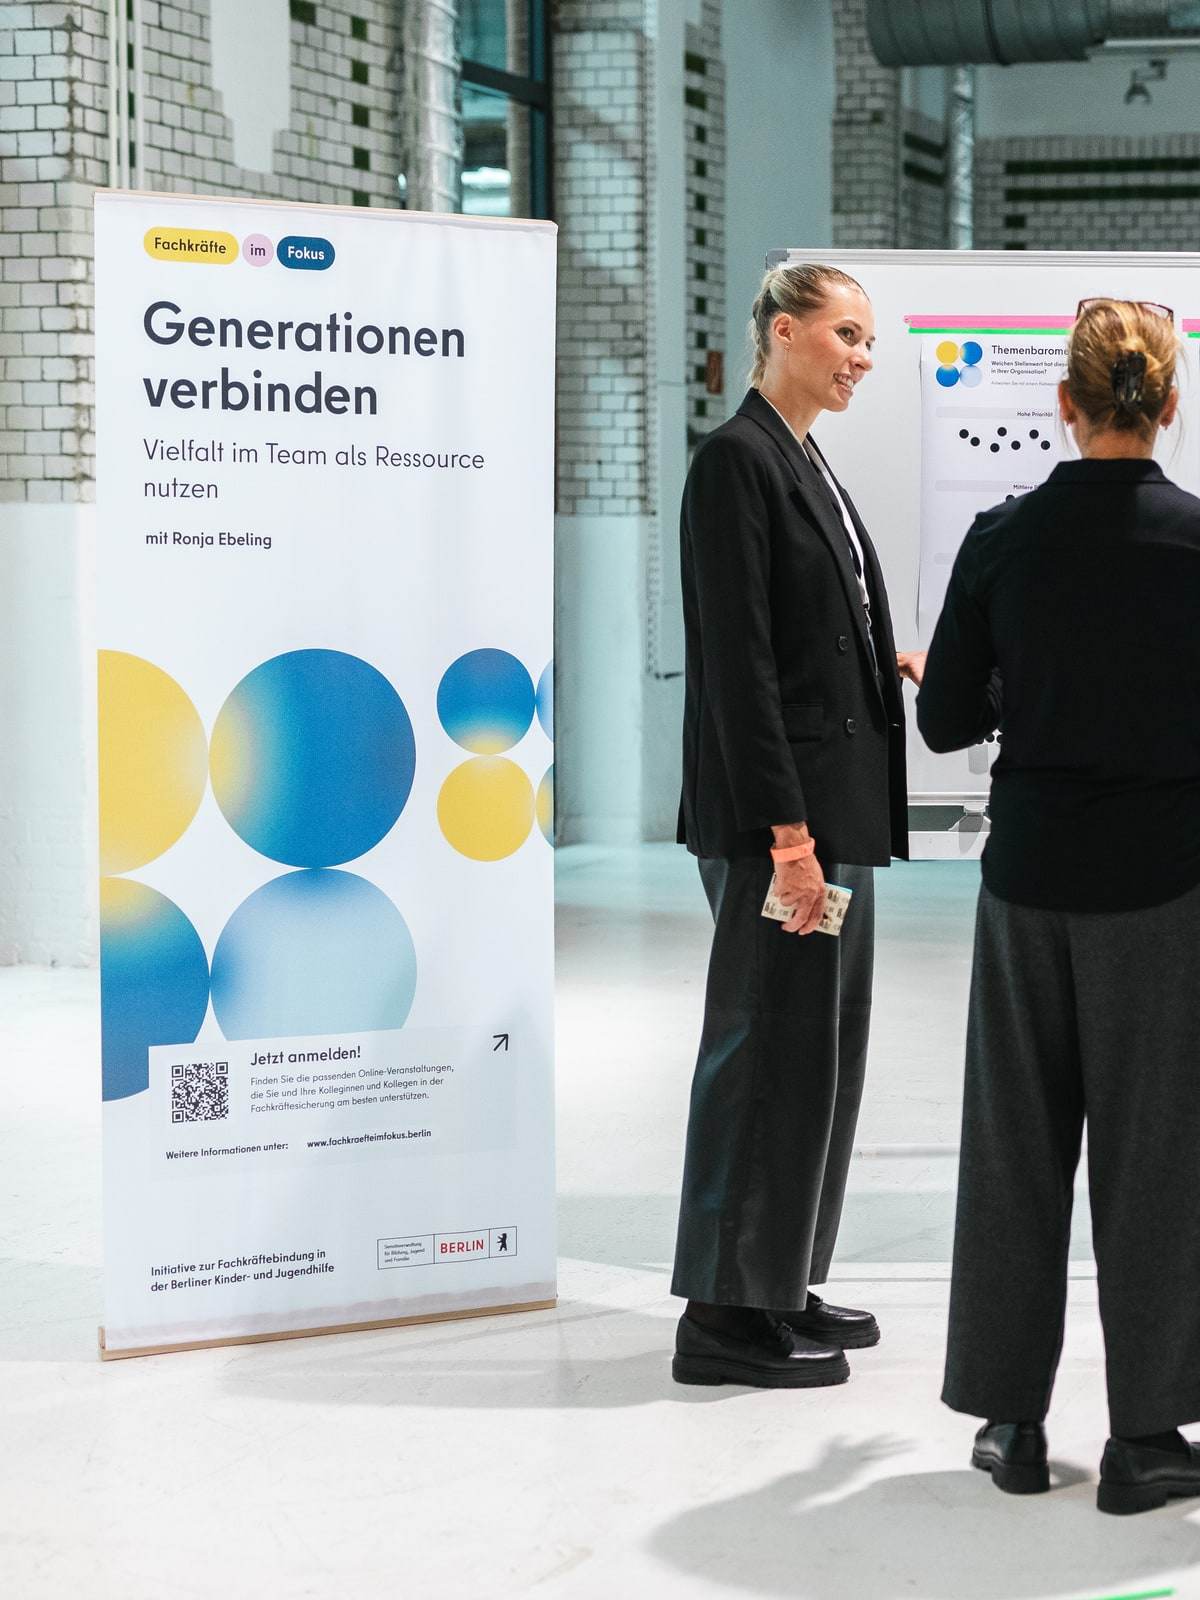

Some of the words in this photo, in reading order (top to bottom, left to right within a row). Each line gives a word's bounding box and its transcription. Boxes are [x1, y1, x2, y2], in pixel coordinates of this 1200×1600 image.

[154, 237, 227, 254] Fachkräfte
[250, 244, 266, 257] im
[287, 245, 325, 260] Fokus
[143, 300, 465, 357] Generationen
[143, 367, 378, 415] verbinden
[144, 438, 224, 462] Vielfalt
[232, 442, 258, 463] im
[266, 442, 327, 465] Team
[335, 444, 367, 466] als
[376, 446, 485, 469] Ressource
[144, 478, 218, 499] nutzen
[146, 532, 168, 546] mit
[173, 532, 214, 549] Ronja
[218, 532, 272, 550] Ebeling
[250, 1051, 284, 1066] Jetzt
[288, 1045, 361, 1064] anmelden!
[250, 1076, 278, 1086] Finden
[280, 1074, 294, 1084] Sie
[296, 1073, 310, 1083] die
[312, 1070, 356, 1083] passenden
[358, 1064, 454, 1078] Online-Veranstaltungen,
[250, 1090, 264, 1100] die
[266, 1089, 279, 1098] Sie
[282, 1088, 298, 1098] und
[300, 1086, 316, 1096] Ihre
[318, 1084, 365, 1096] Kolleginnen
[366, 1080, 381, 1091] und
[383, 1078, 418, 1092] Kollegen
[420, 1078, 428, 1086] in
[430, 1076, 444, 1086] der
[250, 1098, 335, 1113] Fachkräftesicherung
[336, 1098, 350, 1106] am
[352, 1094, 378, 1106] besten
[380, 1091, 430, 1103] unterstützen.
[166, 1150, 198, 1160] Weitere
[201, 1145, 262, 1157] Informationen
[263, 1142, 288, 1151] unter:
[307, 1128, 432, 1148] www.fachkraefteimfokus.berlin
[440, 1240, 484, 1254] BERLIN
[151, 1263, 196, 1276] Initiative
[199, 1262, 216, 1271] zur
[218, 1251, 314, 1269] Fachkräftebindung
[316, 1249, 326, 1258] in
[150, 1282, 169, 1292] der
[171, 1276, 212, 1290] Berliner
[214, 1272, 251, 1285] Kinder-
[254, 1269, 273, 1280] und
[274, 1262, 335, 1280] Jugendhilfe
